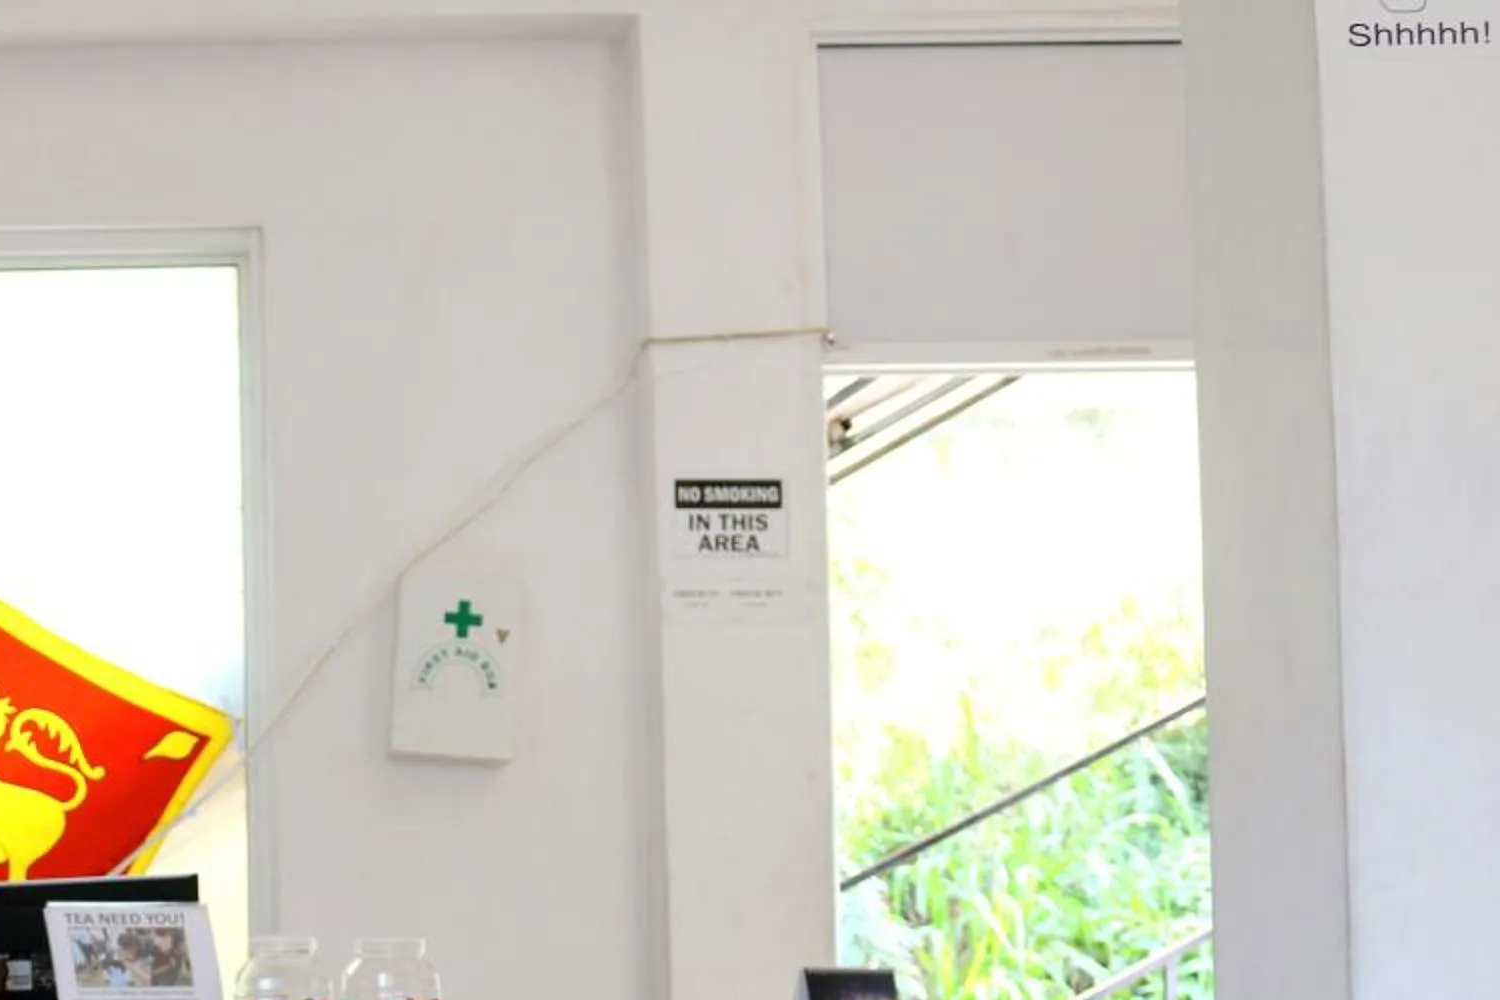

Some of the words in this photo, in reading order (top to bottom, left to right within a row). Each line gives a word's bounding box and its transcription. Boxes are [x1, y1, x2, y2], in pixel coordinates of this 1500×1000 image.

[1348, 21, 1491, 47] Shhhhh!
[677, 485, 701, 502] NO
[703, 485, 779, 502] SMOKING
[688, 513, 710, 532] IN
[718, 513, 769, 532] THIS
[698, 534, 760, 552] AREA
[98, 911, 142, 925] NEED
